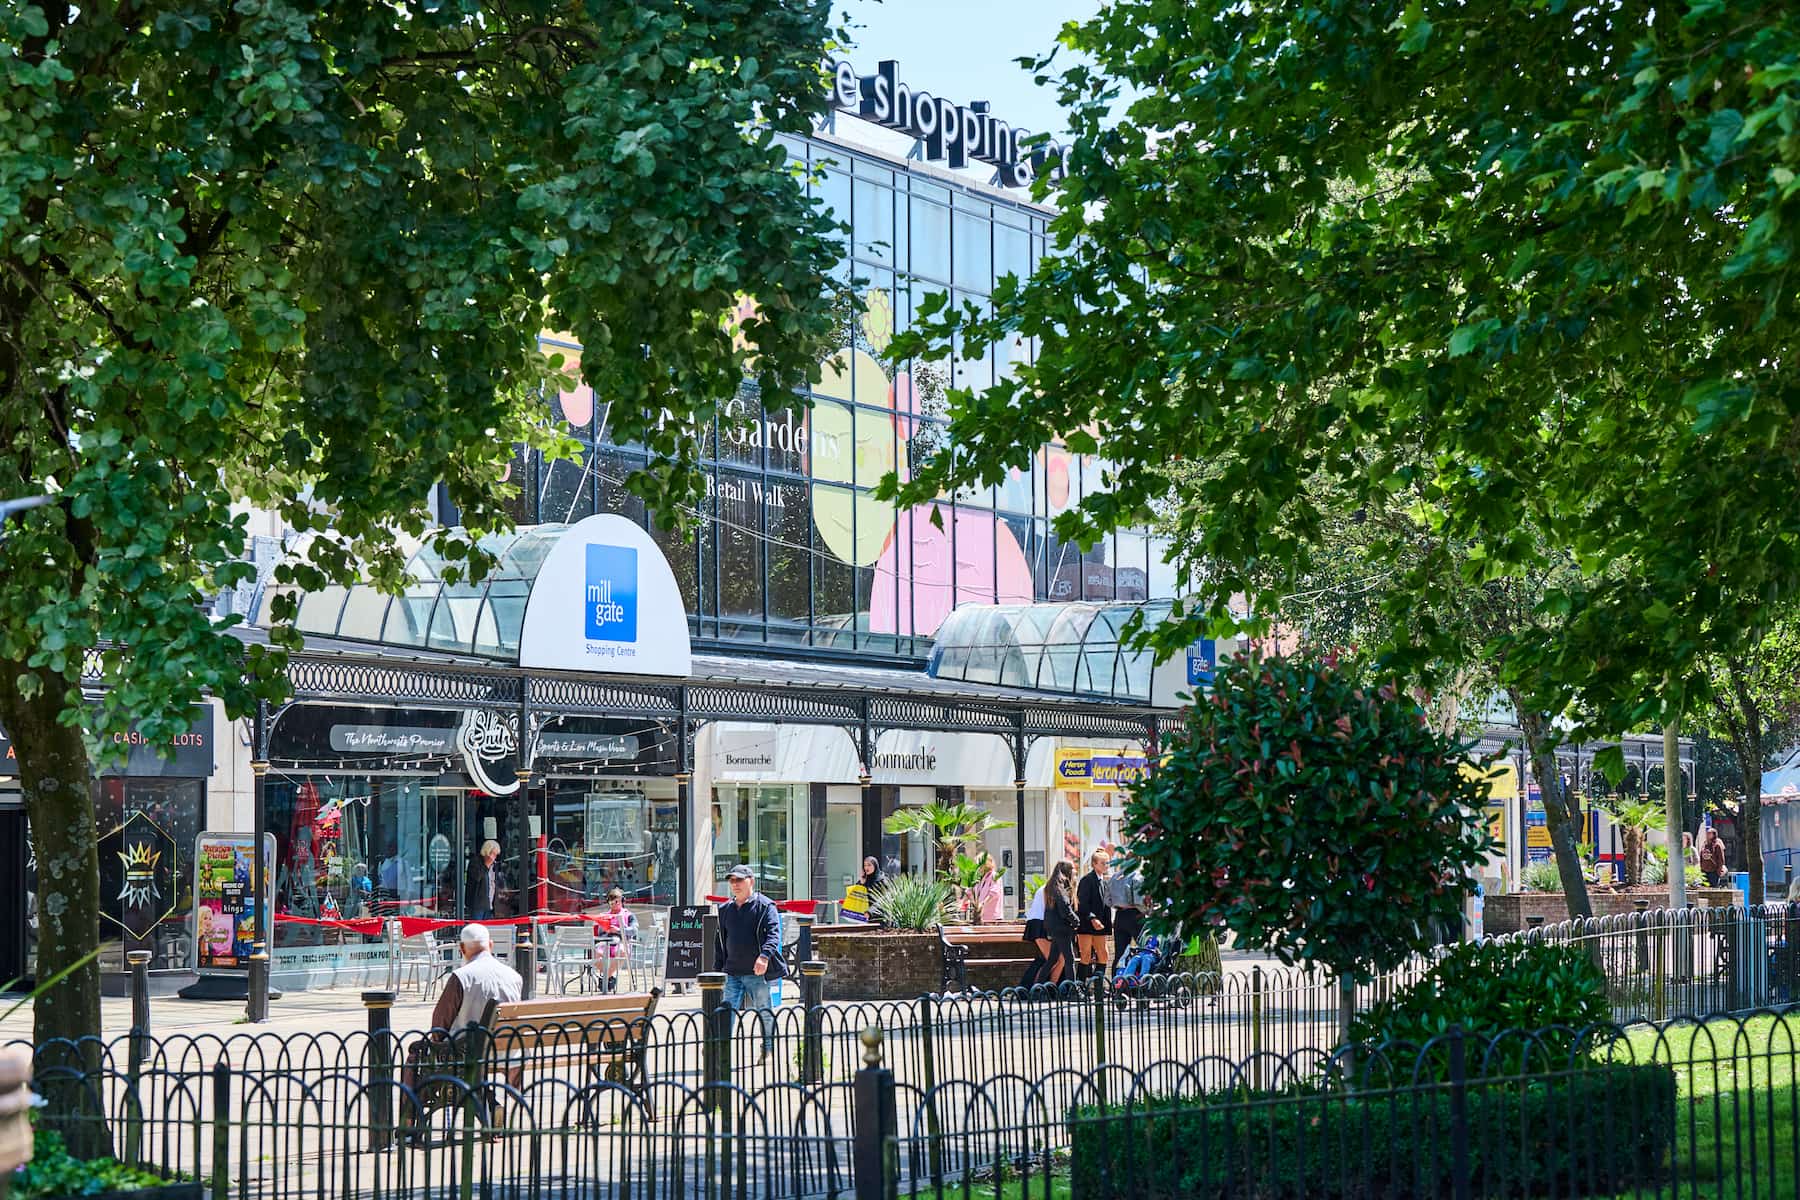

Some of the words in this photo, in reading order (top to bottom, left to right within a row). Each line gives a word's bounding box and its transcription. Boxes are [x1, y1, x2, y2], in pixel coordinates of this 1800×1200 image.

[859, 60, 1031, 188] shopping
[706, 474, 746, 502] Retail
[752, 481, 785, 508] Walk
[587, 579, 612, 604] mill
[595, 601, 624, 627] gate
[585, 643, 615, 658] Shopping
[616, 646, 636, 657] Centre
[169, 733, 203, 746] LOTS
[726, 754, 772, 765] Bonmarché
[1064, 760, 1087, 769] Heron
[1064, 768, 1086, 776] Foods
[223, 905, 244, 914] kings
[683, 908, 697, 918] sky
